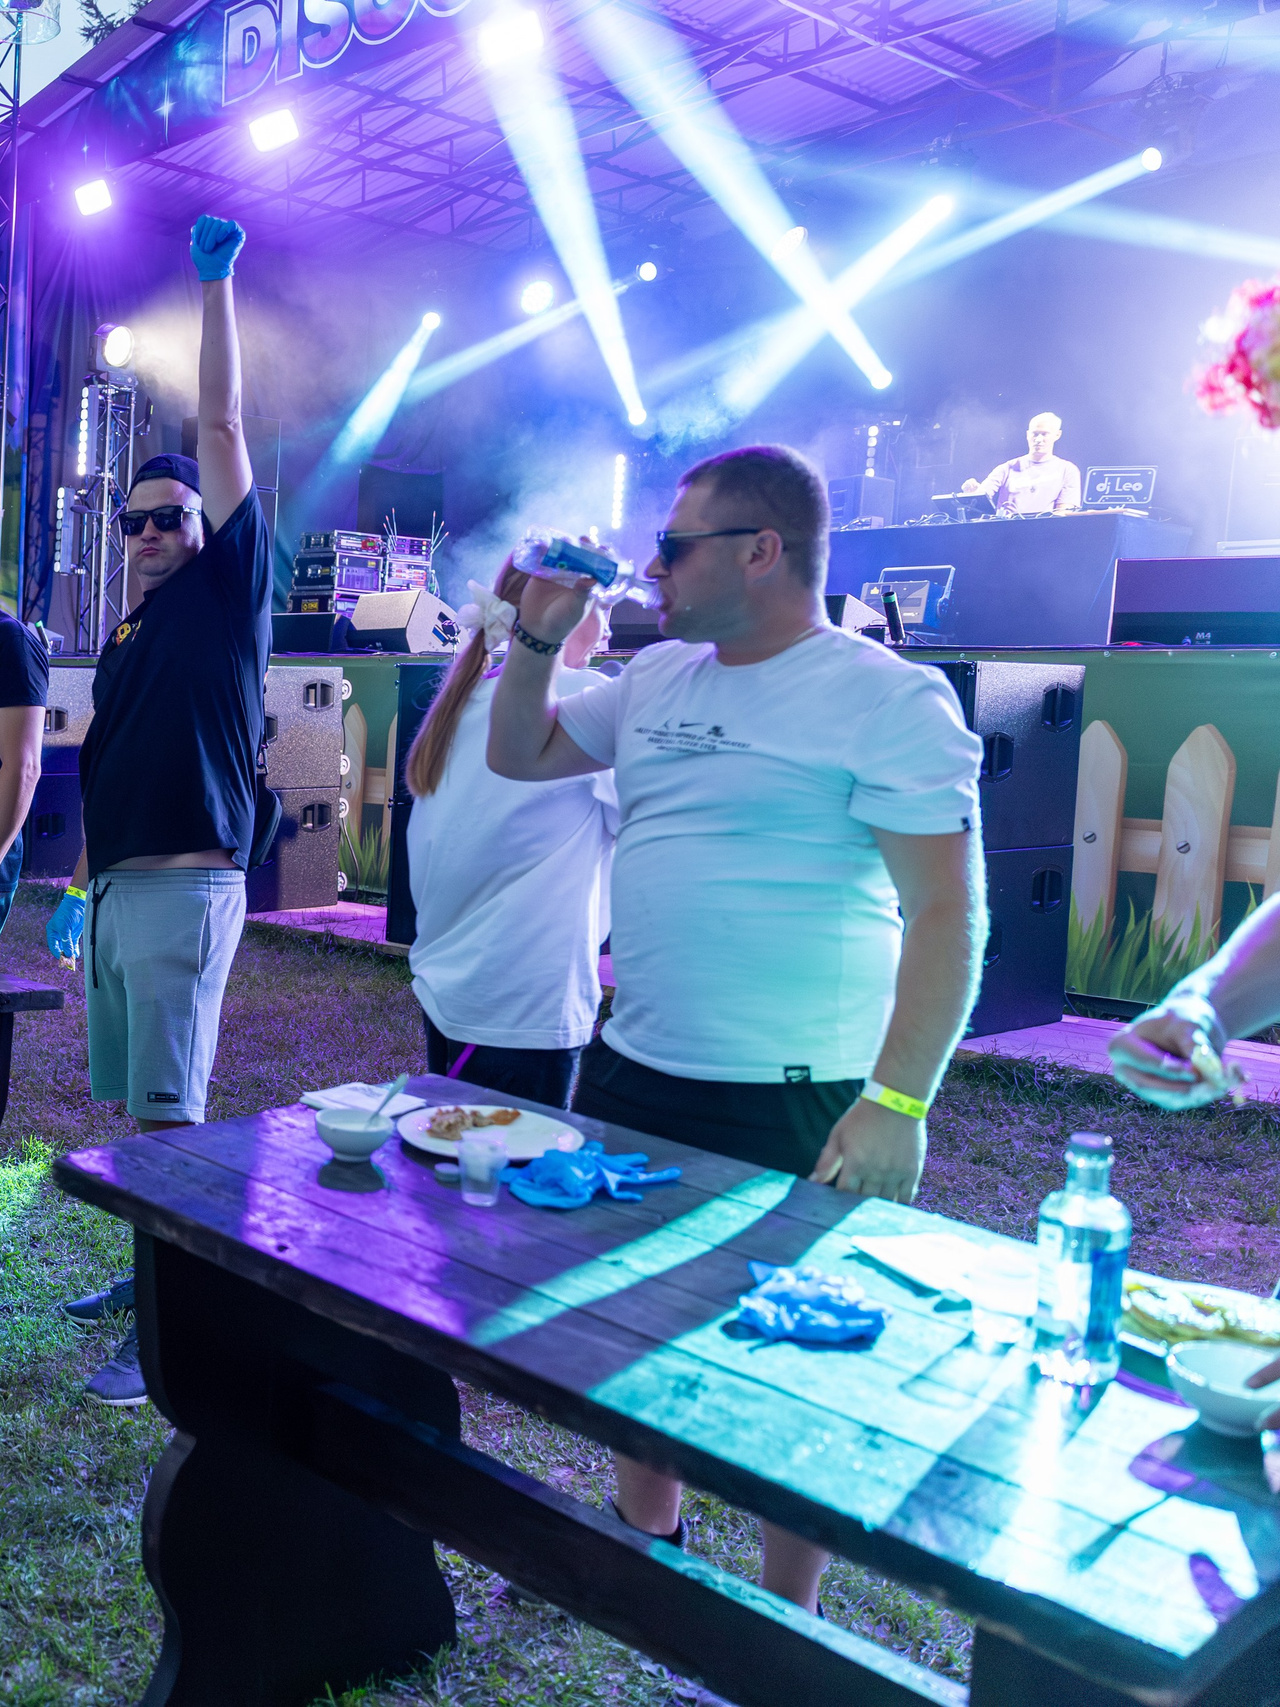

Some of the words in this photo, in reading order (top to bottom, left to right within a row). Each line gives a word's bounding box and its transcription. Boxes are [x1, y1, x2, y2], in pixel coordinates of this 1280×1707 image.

[223, 0, 475, 106] DIS
[1096, 477, 1111, 494] dj
[1115, 477, 1143, 492] Leo
